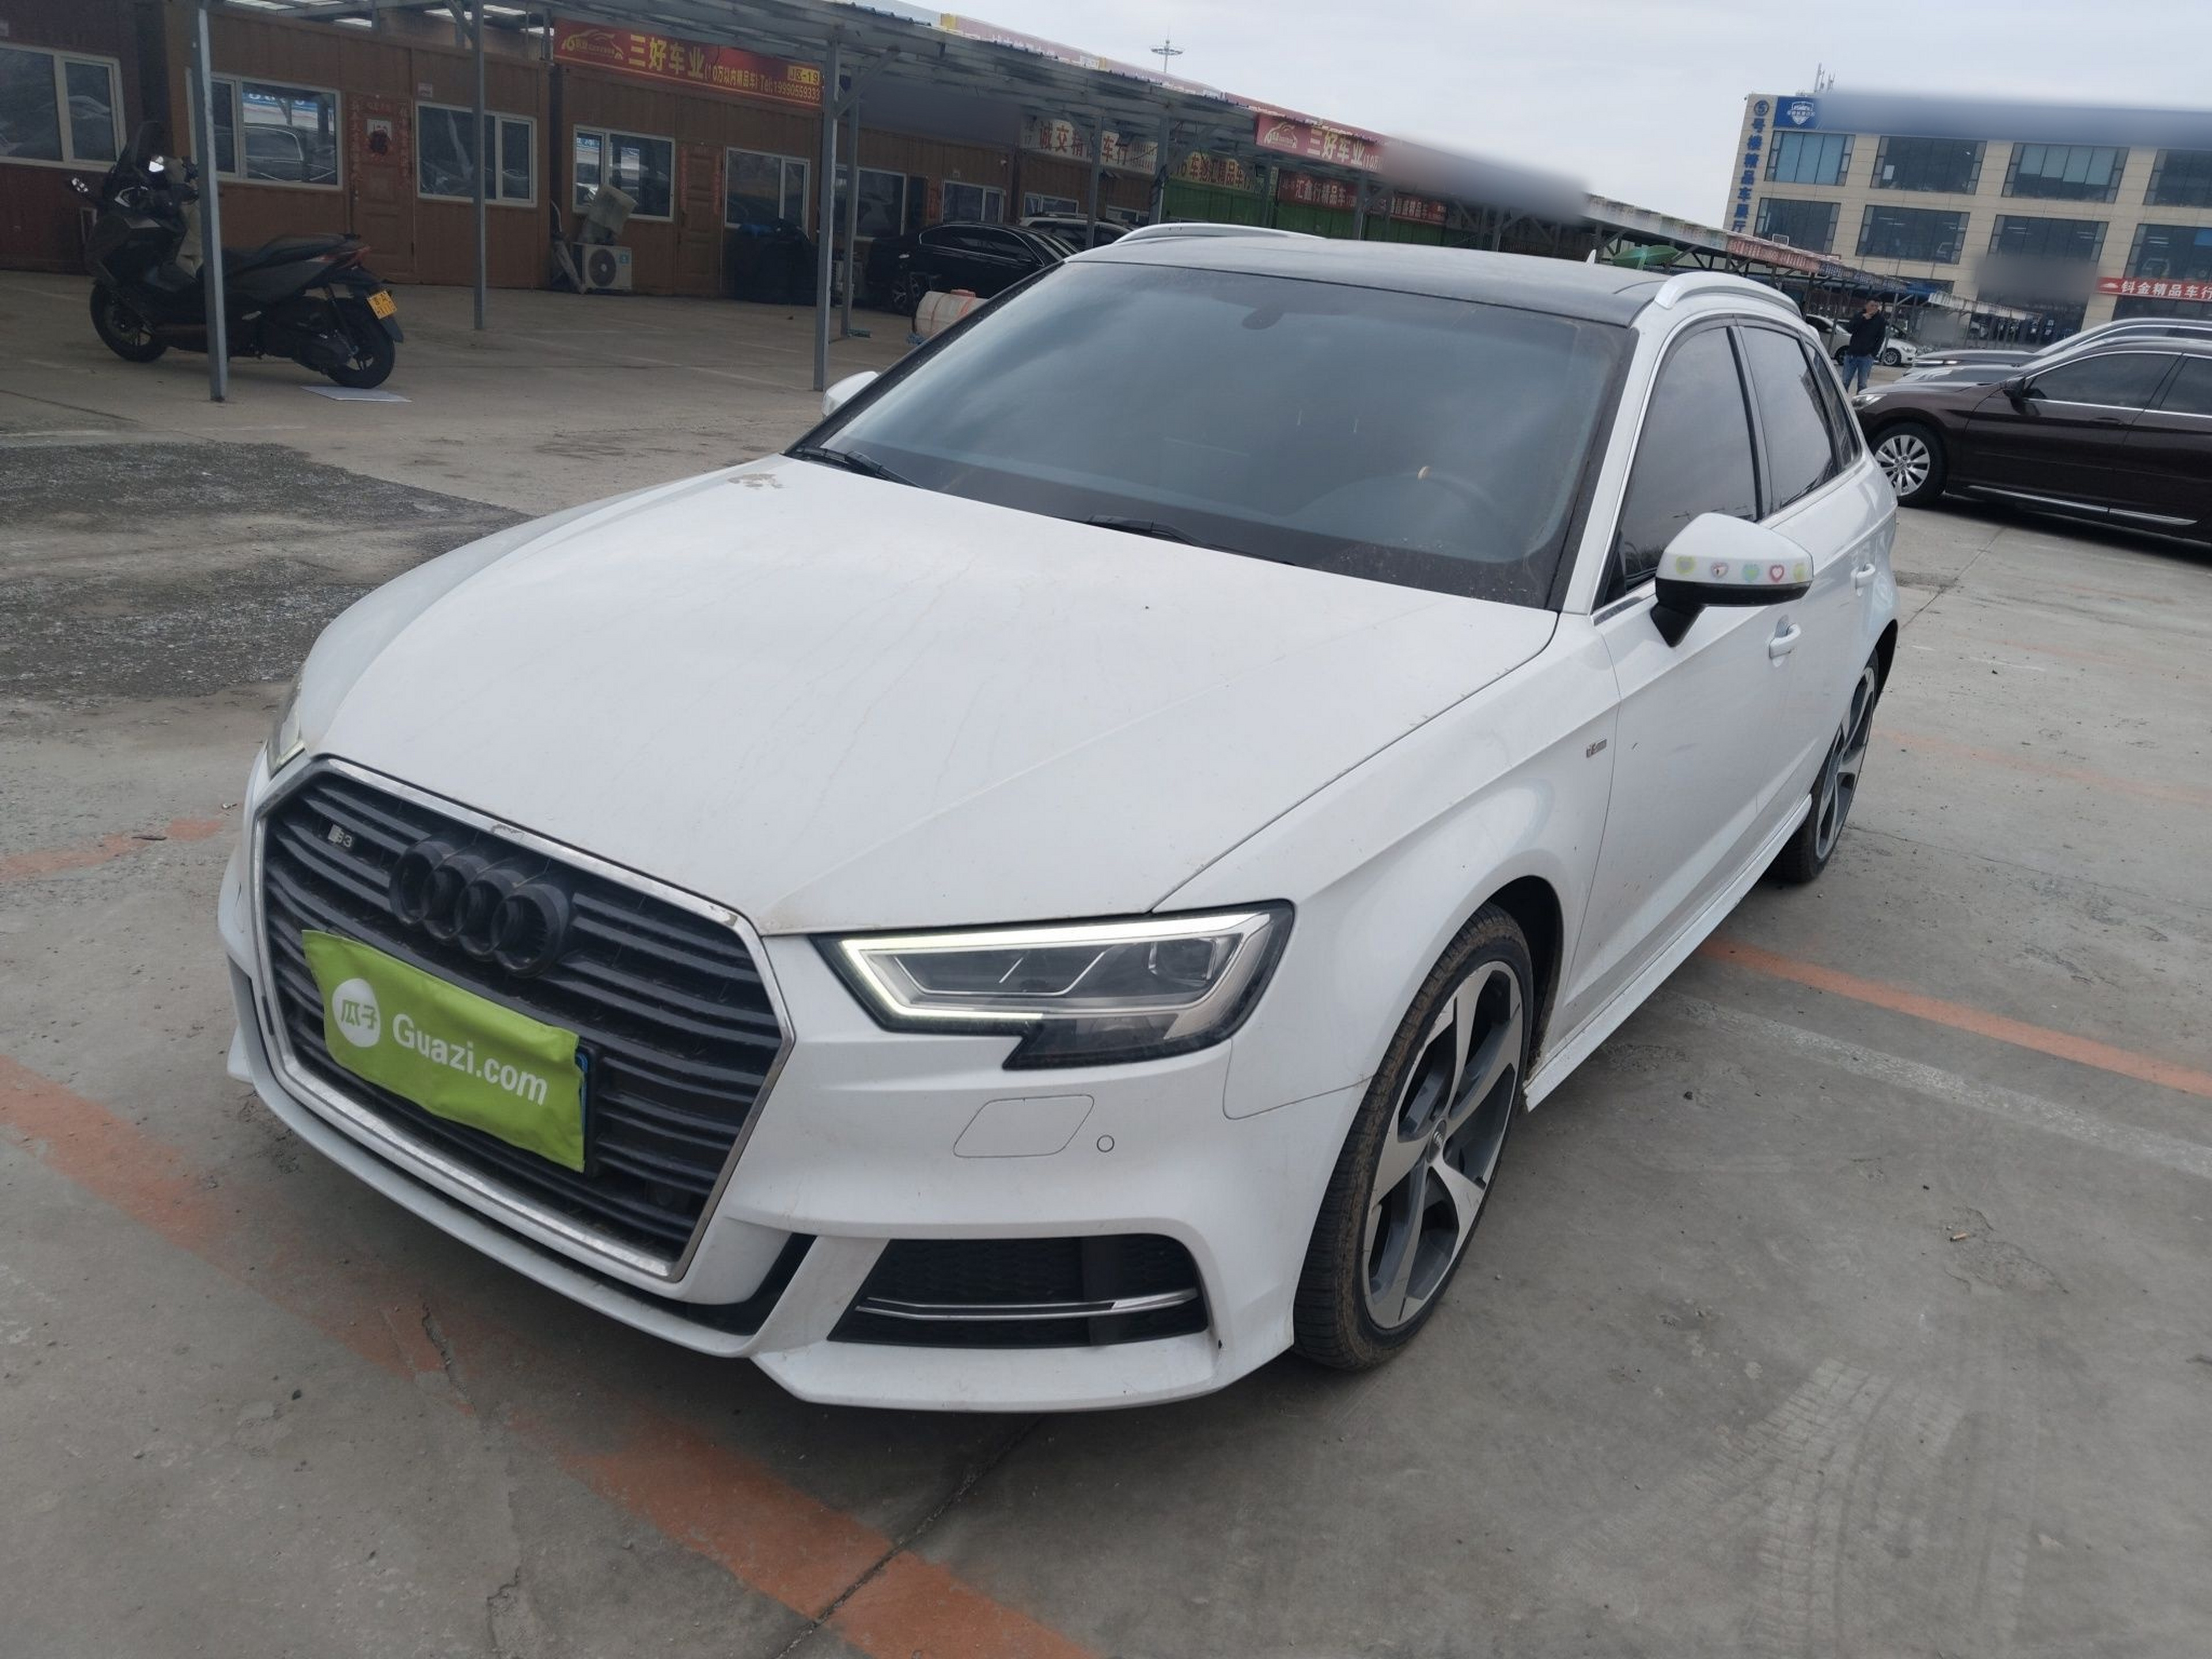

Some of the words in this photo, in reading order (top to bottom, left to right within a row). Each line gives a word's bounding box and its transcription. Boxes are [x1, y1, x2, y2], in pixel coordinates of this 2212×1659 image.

[629, 34, 704, 80] 三好车业
[1307, 127, 1365, 166] 三好车业
[340, 999, 377, 1031] 瓜子
[392, 1013, 548, 1105] Guazi.com
